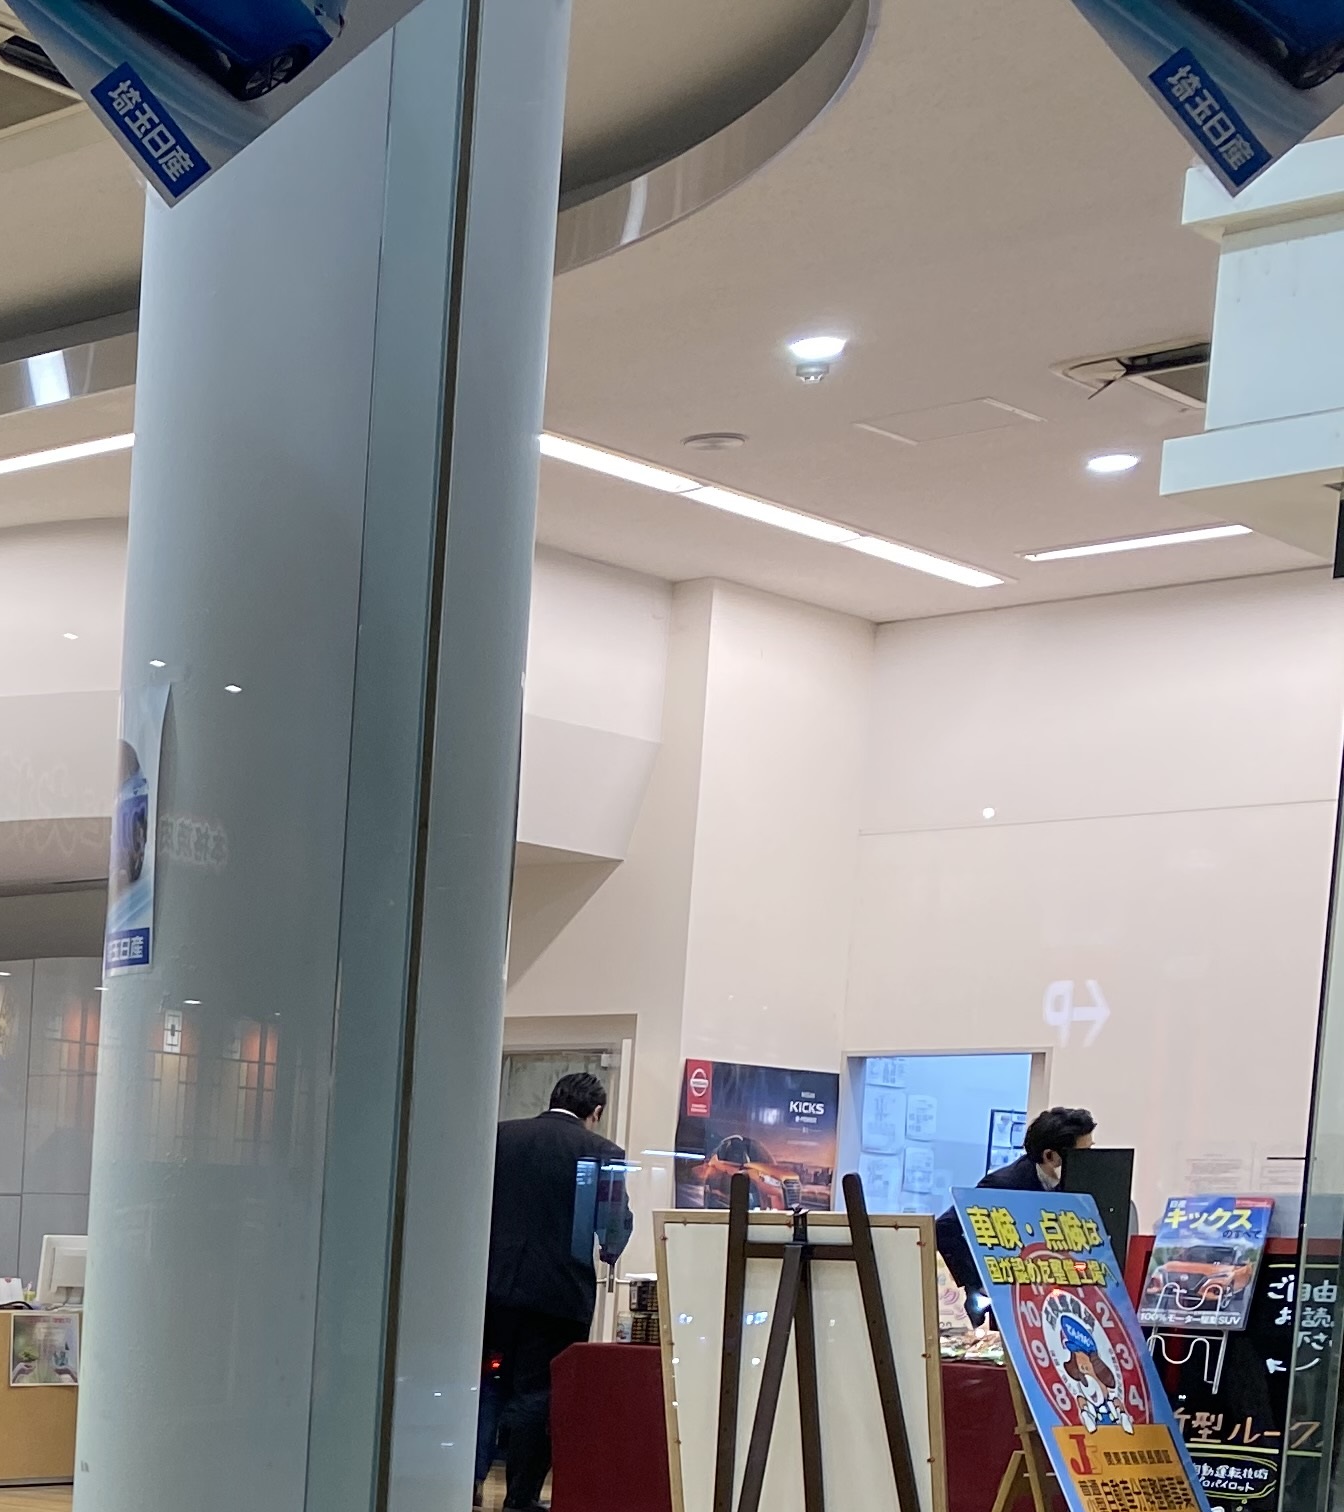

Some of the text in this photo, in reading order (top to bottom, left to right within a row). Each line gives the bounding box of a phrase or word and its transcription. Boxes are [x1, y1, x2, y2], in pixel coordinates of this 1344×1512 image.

[107, 79, 195, 182] 埼玉日産
[1166, 64, 1256, 172] 埼玉日産
[106, 935, 144, 960] 玉日産
[789, 1100, 825, 1115] KICKS
[966, 1205, 1104, 1253] 車検・点検は
[1164, 1208, 1253, 1231] キックス
[1222, 1230, 1262, 1239] のすべて
[1020, 1300, 1043, 1328] 10
[1095, 1301, 1115, 1328] 2
[1031, 1339, 1050, 1368] 9
[1116, 1343, 1134, 1371] 3
[1052, 1382, 1072, 1411] 8
[1129, 1384, 1146, 1411] 4
